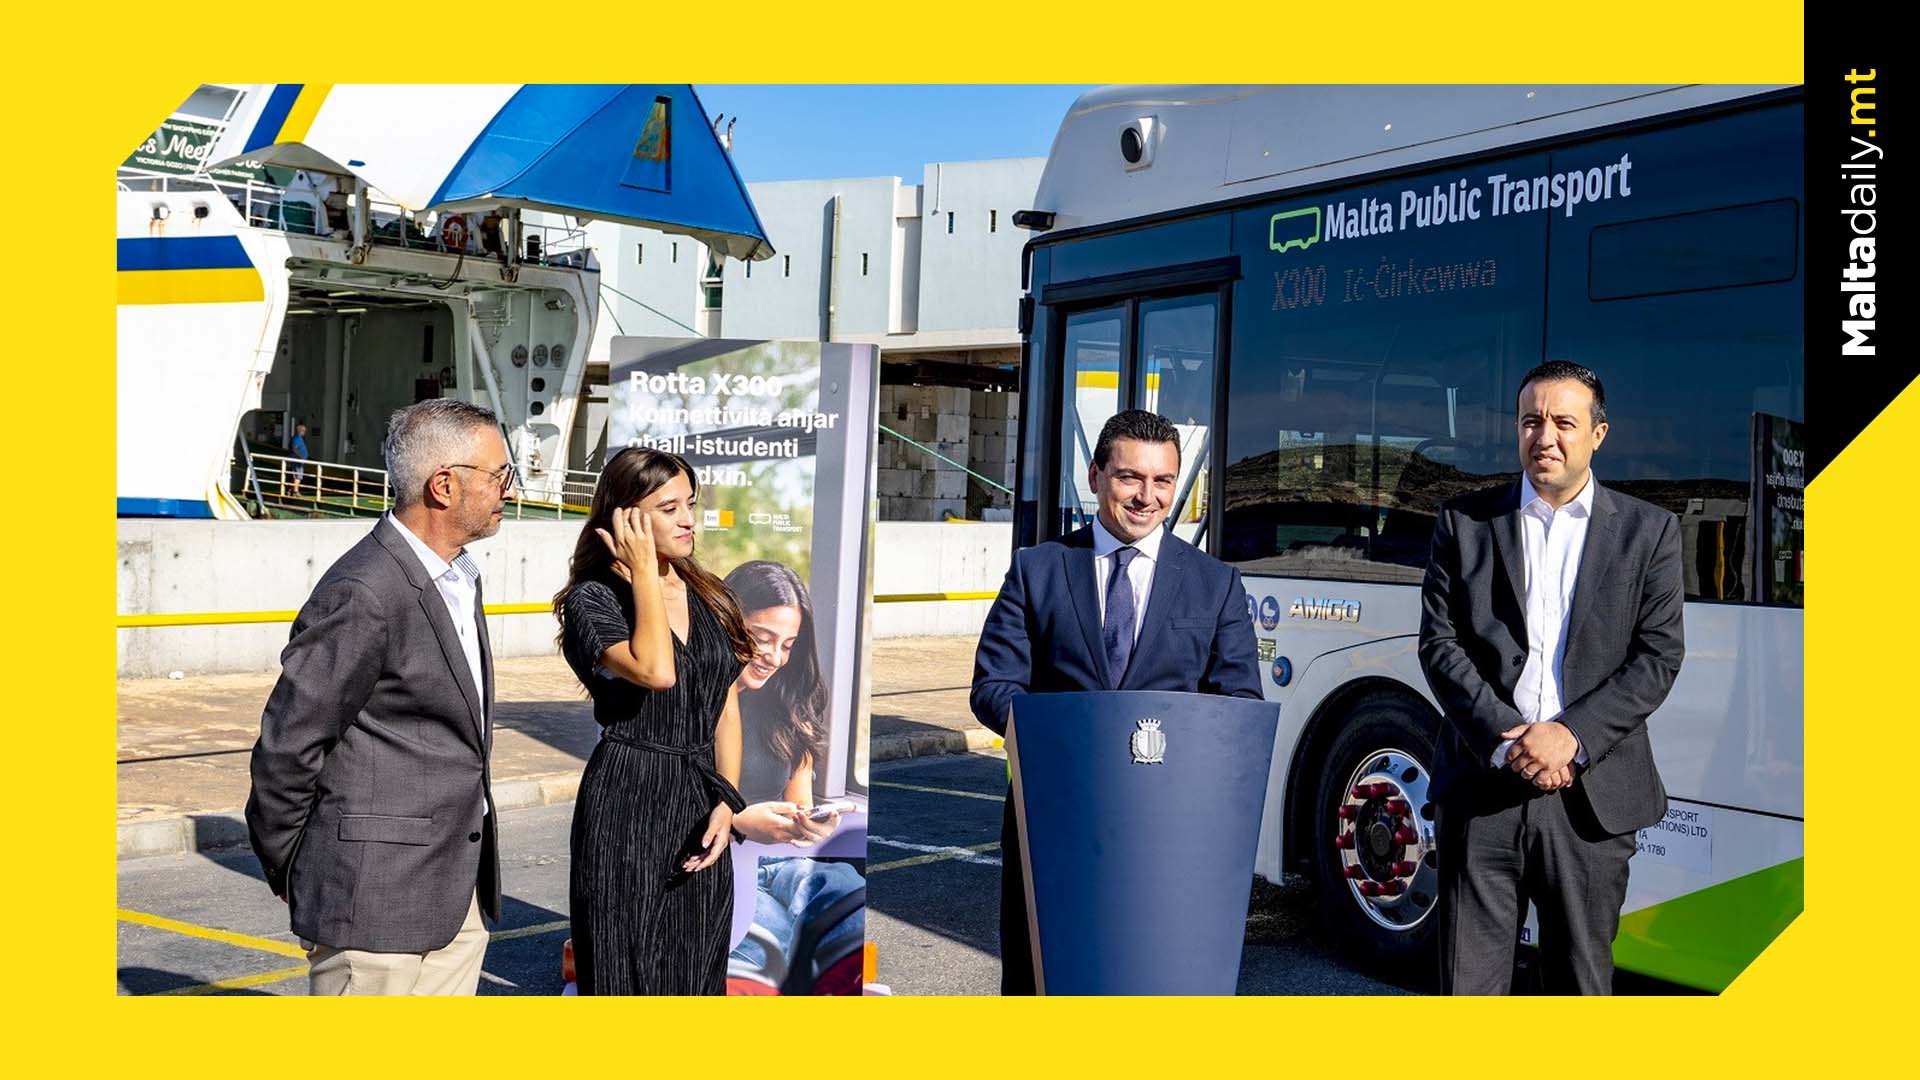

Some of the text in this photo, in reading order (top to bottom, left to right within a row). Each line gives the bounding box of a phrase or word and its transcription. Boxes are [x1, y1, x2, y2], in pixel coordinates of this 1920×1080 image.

[137, 138, 157, 154] s
[1324, 152, 1633, 242] Malta Public Transport
[1271, 264, 1329, 311] X300
[629, 370, 784, 398] Rotta X300
[696, 465, 753, 487] dxin.
[1288, 595, 1362, 623] AMIGO
[1690, 825, 1708, 838] LTD
[1647, 843, 1666, 857] 1780
